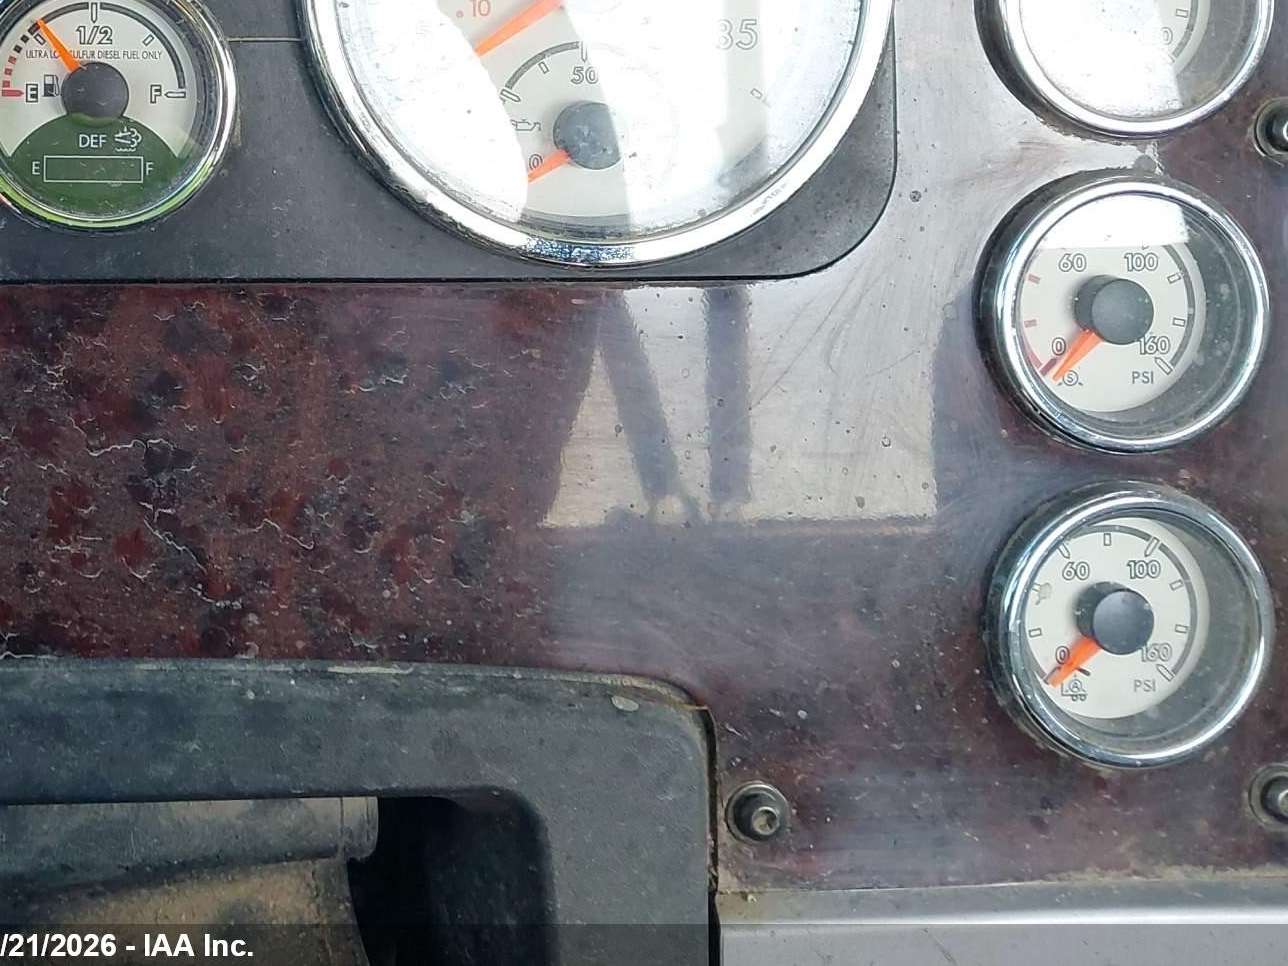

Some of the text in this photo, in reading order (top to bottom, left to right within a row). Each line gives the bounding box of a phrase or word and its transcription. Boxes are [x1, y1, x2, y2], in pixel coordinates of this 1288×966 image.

[470, 0, 491, 17] 10
[76, 26, 113, 45] 1/2
[26, 50, 49, 59] ULTRA
[97, 50, 120, 59] DIESEL
[123, 50, 140, 59] FUEL
[142, 50, 162, 59] ONLY
[571, 66, 598, 84] 50
[26, 84, 38, 103] E
[150, 85, 162, 104] F
[79, 134, 107, 147] DEF
[32, 162, 40, 174] E
[145, 162, 153, 174] F
[529, 153, 543, 170] 0
[1059, 253, 1087, 272] 60
[1124, 252, 1158, 271] 100
[1052, 337, 1066, 355] 0
[1139, 336, 1170, 354] 160
[1132, 371, 1154, 384] PSI
[1063, 562, 1090, 580] 60
[1127, 560, 1161, 579] 100
[1055, 646, 1070, 665] 0
[1134, 679, 1156, 692] PSI
